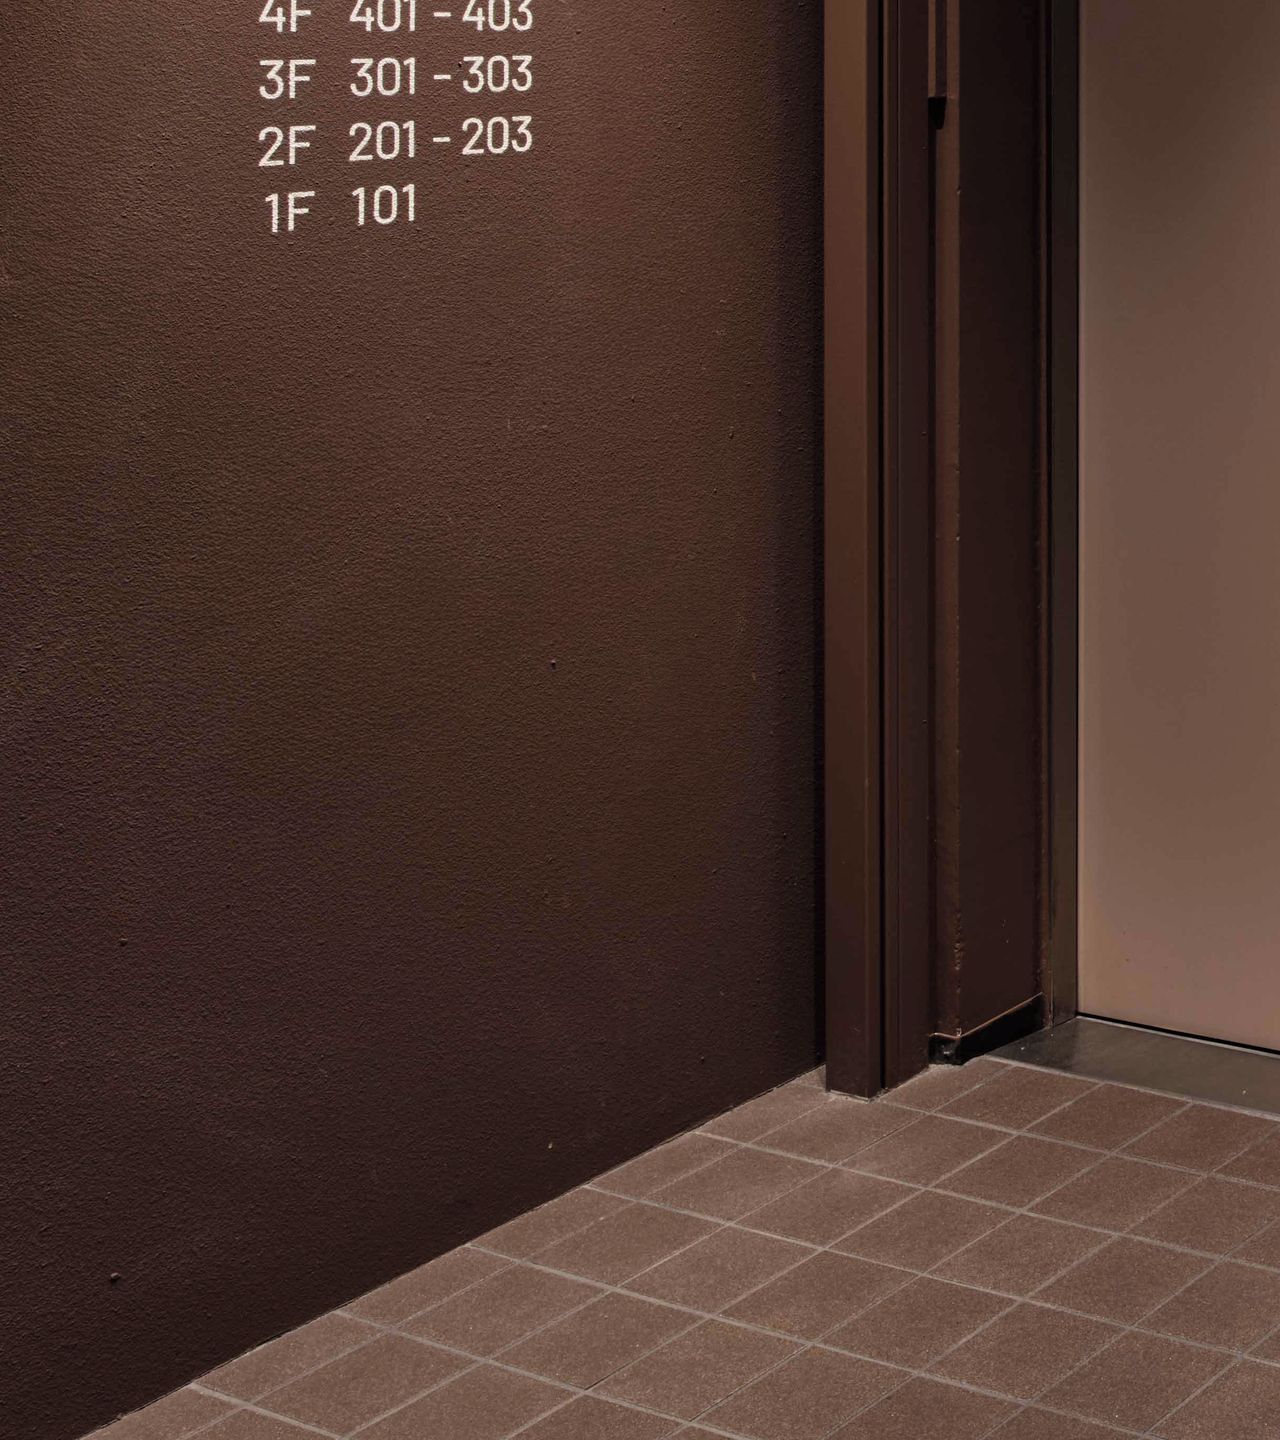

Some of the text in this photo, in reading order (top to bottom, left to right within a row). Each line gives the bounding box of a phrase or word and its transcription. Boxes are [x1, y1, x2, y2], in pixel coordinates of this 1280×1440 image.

[259, 59, 316, 99] 3F
[350, 58, 416, 96] 301
[462, 55, 532, 93] 303
[259, 125, 316, 167] 2F
[349, 121, 415, 161] 201
[462, 116, 532, 155] 203
[265, 183, 415, 232] 1F 101
